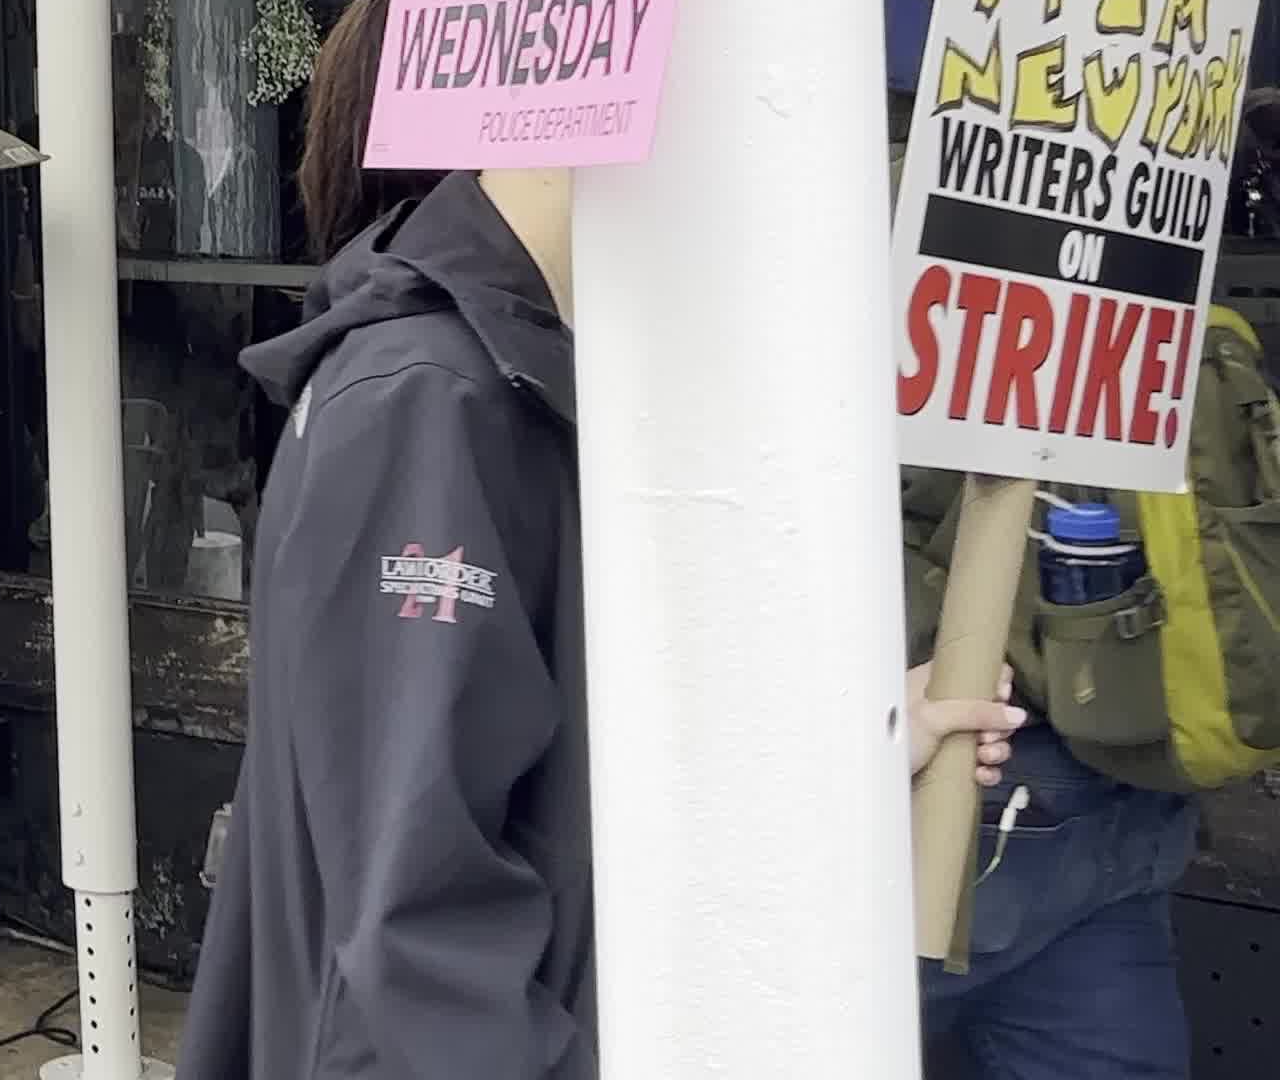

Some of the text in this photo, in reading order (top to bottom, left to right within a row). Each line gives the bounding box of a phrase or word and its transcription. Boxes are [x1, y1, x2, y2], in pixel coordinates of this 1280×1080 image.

[479, 101, 638, 143] POLICE DEPARTMENT
[931, 18, 1140, 153] NEW
[938, 117, 1212, 242] WRITERS GUILD
[1058, 231, 1105, 282] ON
[897, 265, 1195, 449] STRIKE!
